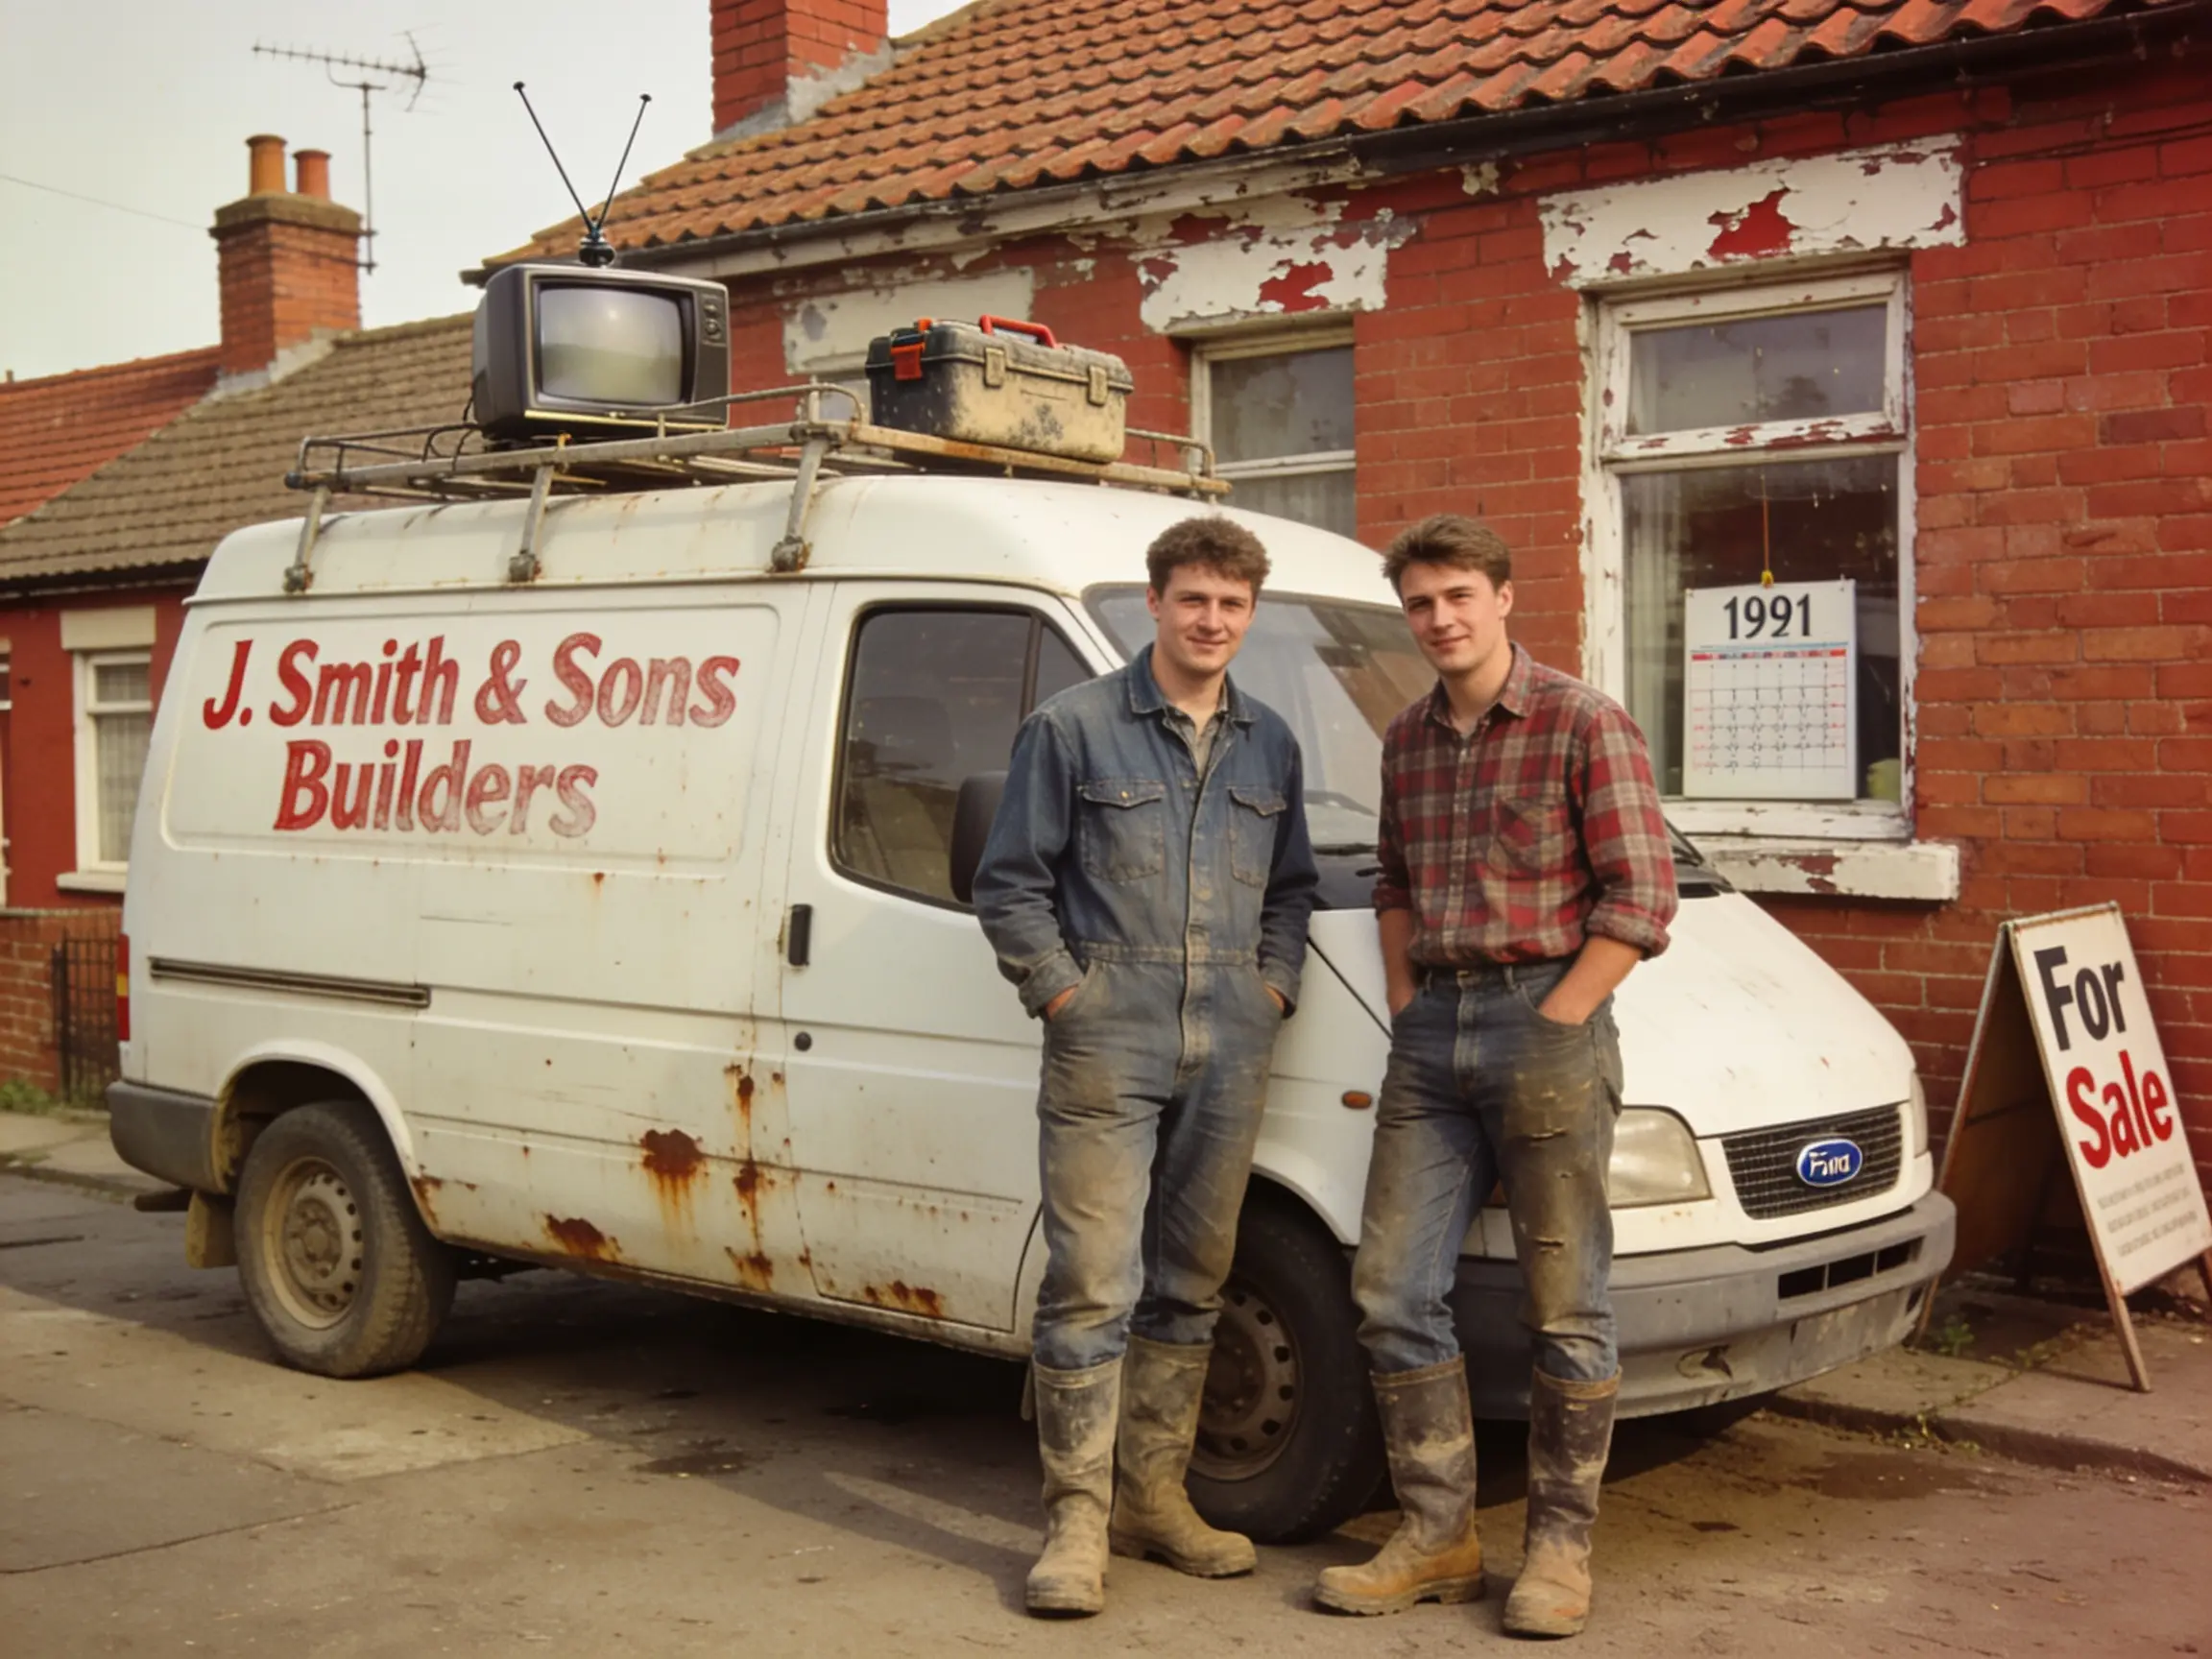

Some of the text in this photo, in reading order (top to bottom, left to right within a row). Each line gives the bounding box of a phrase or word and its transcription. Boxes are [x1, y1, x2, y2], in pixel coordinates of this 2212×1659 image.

[1723, 593, 1812, 639] 1991
[203, 632, 741, 731] J. Smith & Sons
[273, 738, 599, 838] Builders
[2033, 945, 2127, 1052] For
[2066, 1049, 2174, 1168] Sale
